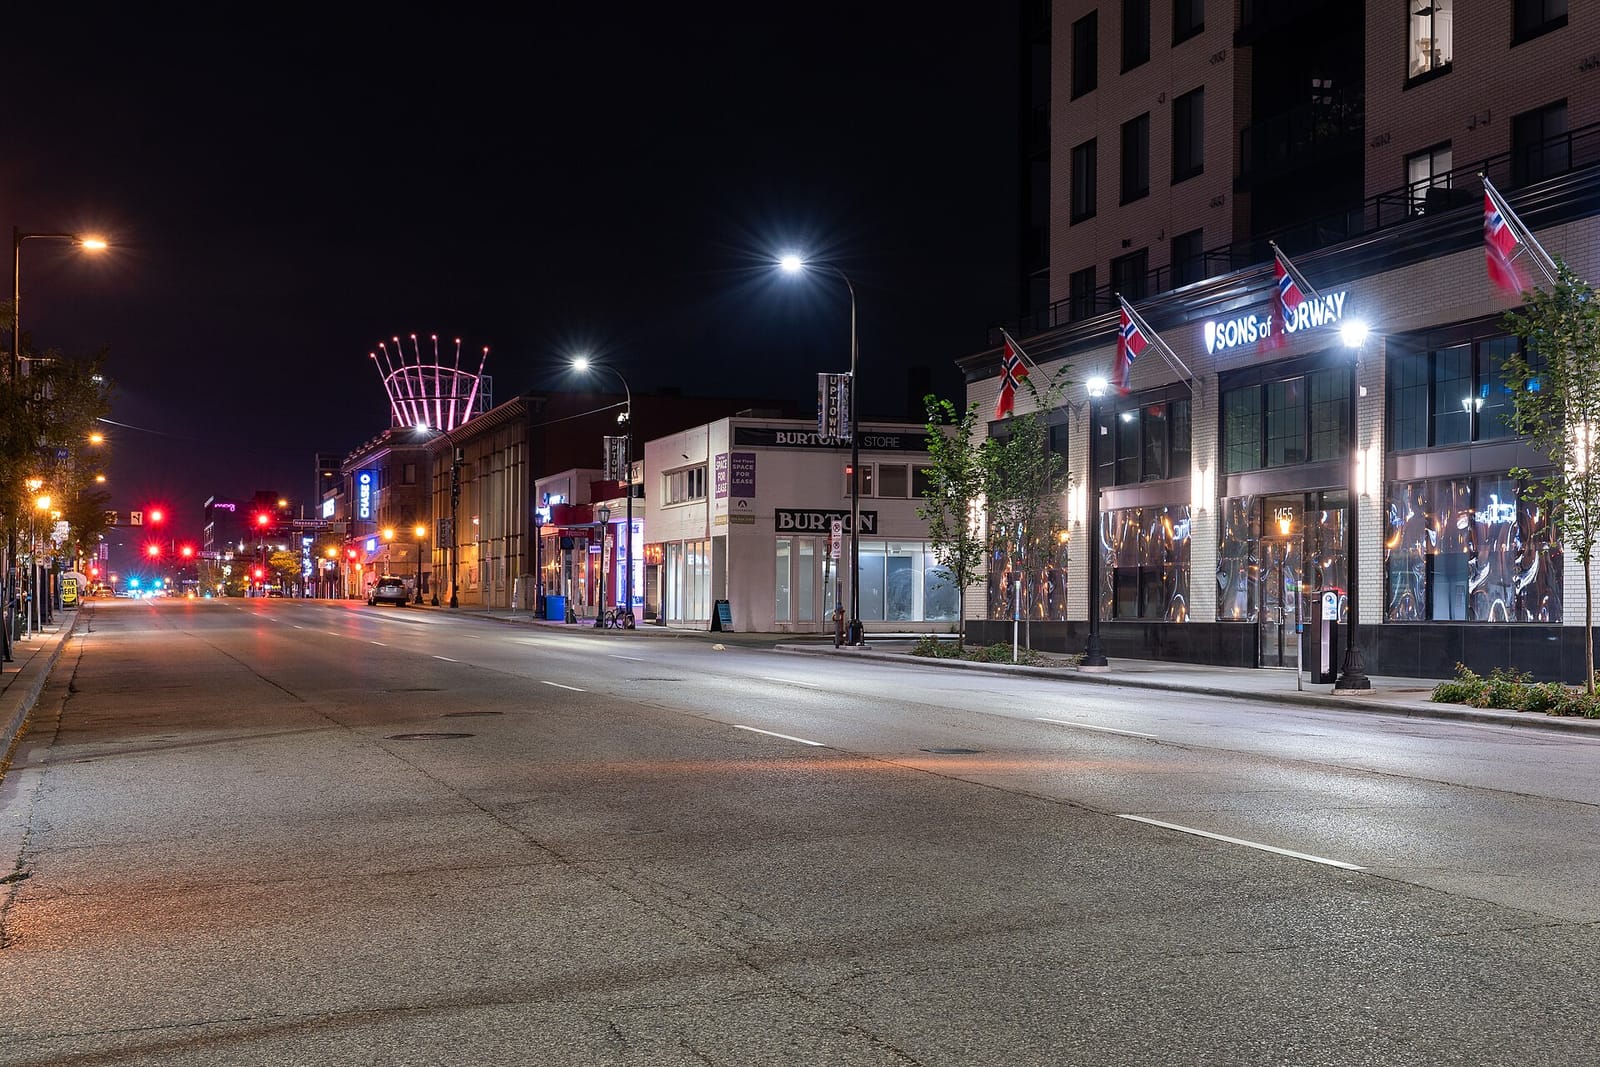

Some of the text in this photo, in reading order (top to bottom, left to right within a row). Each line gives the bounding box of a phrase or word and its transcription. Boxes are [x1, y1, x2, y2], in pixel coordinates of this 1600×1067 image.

[1216, 291, 1346, 350] SONS of ORWAY
[829, 376, 837, 437] UPTOWN
[776, 432, 900, 448] BURTON STORE
[715, 459, 727, 470] SPACE
[717, 471, 726, 482] FOR
[715, 482, 727, 493] LEASE
[360, 484, 369, 518] CHASE
[1273, 507, 1293, 523] 1455
